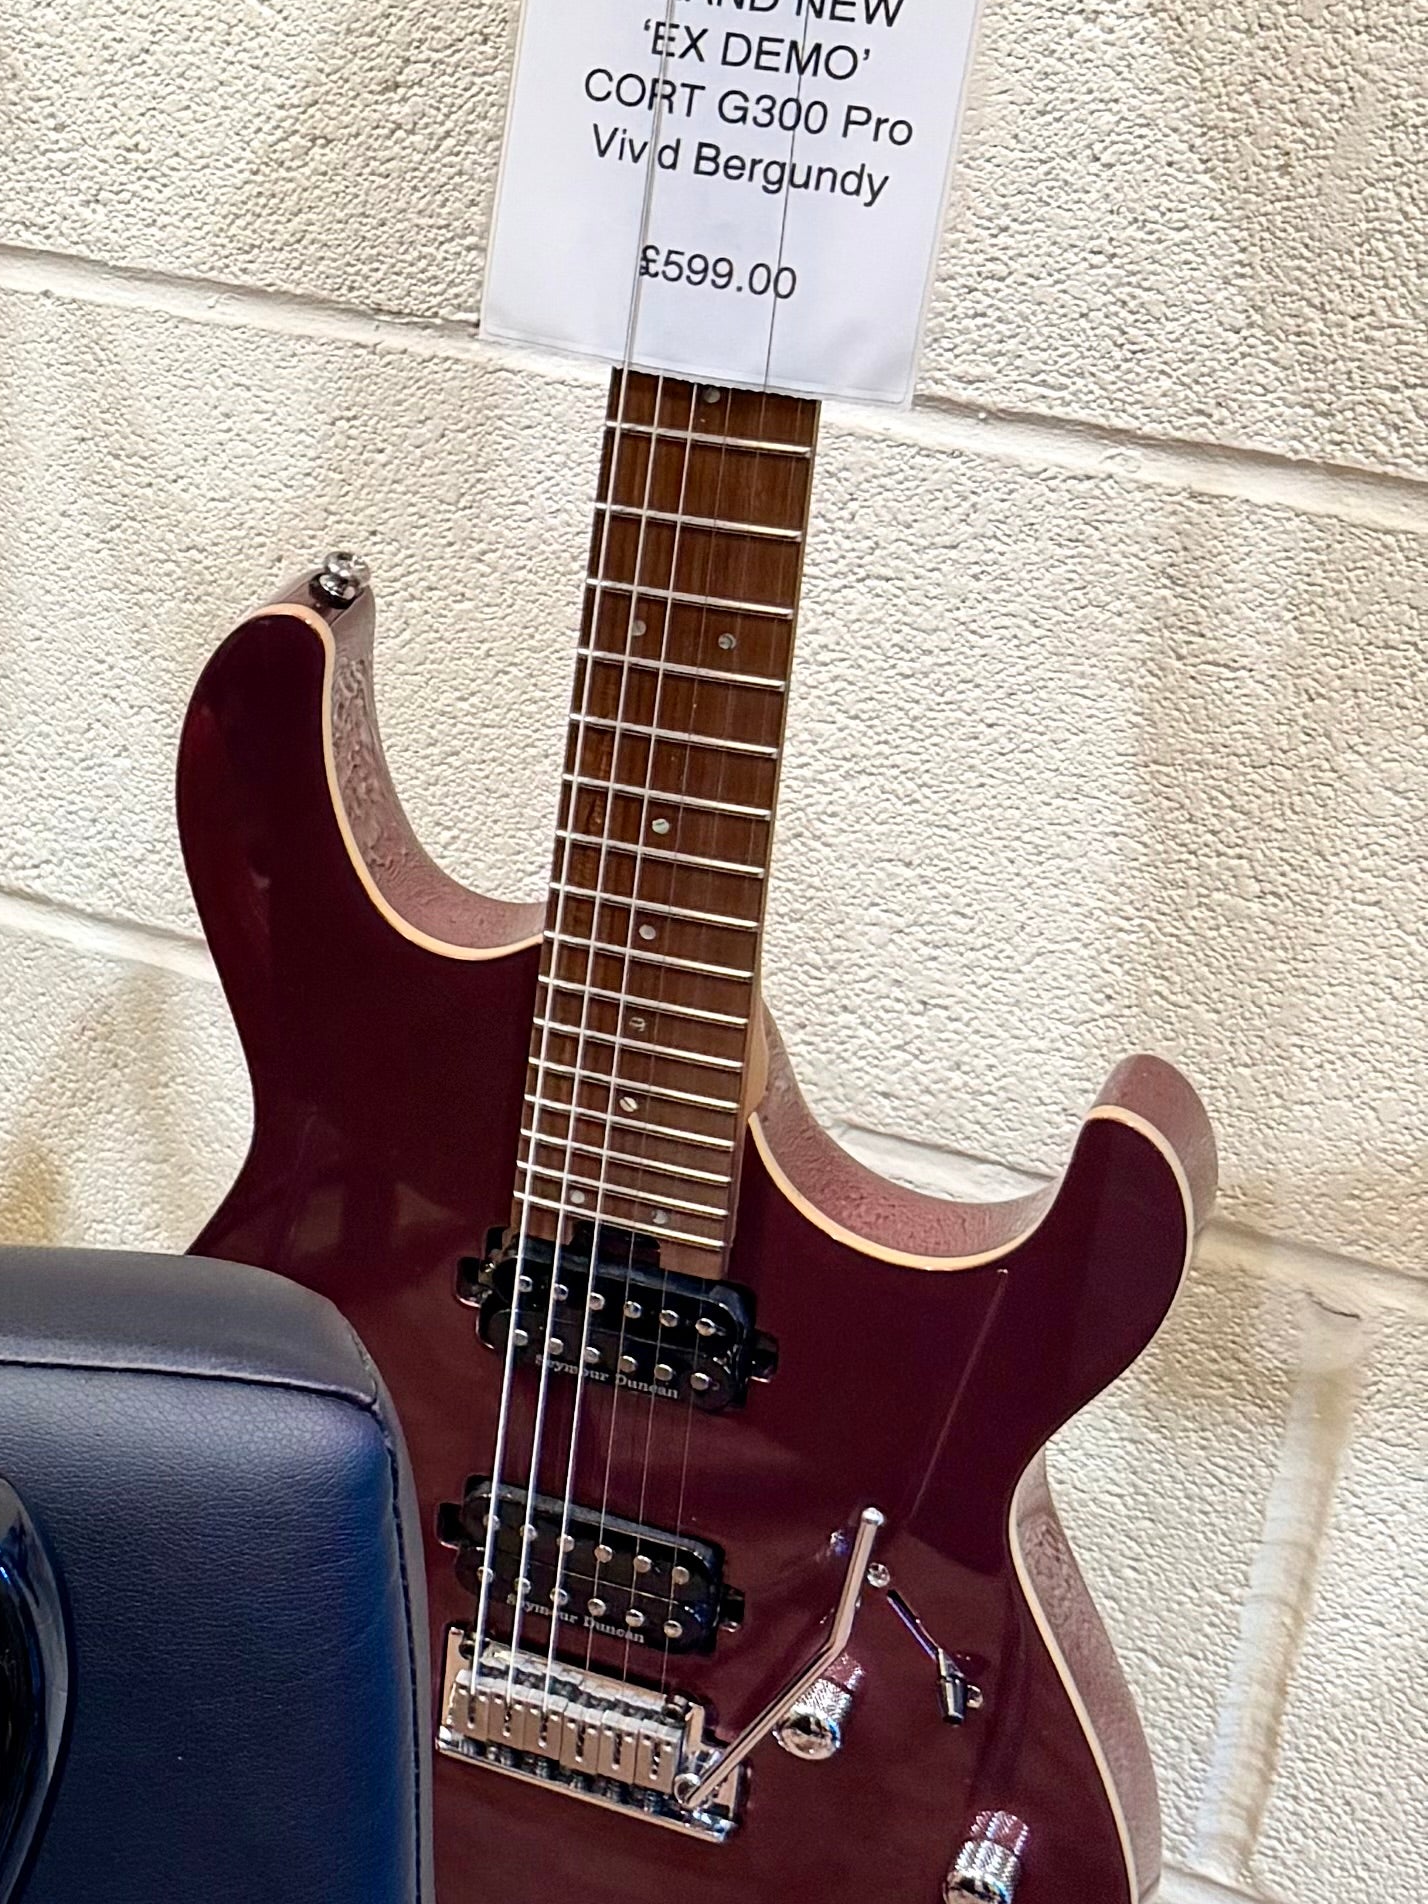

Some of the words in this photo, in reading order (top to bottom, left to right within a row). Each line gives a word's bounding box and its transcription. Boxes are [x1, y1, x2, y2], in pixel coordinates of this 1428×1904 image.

[584, 68, 706, 118] CORT
[717, 90, 828, 135] G300
[842, 105, 913, 146] Pro
[694, 141, 890, 208] Bergundy
[638, 244, 797, 299] £599.00
[614, 1373, 679, 1400] Duncan
[584, 1615, 645, 1643] Duncan
